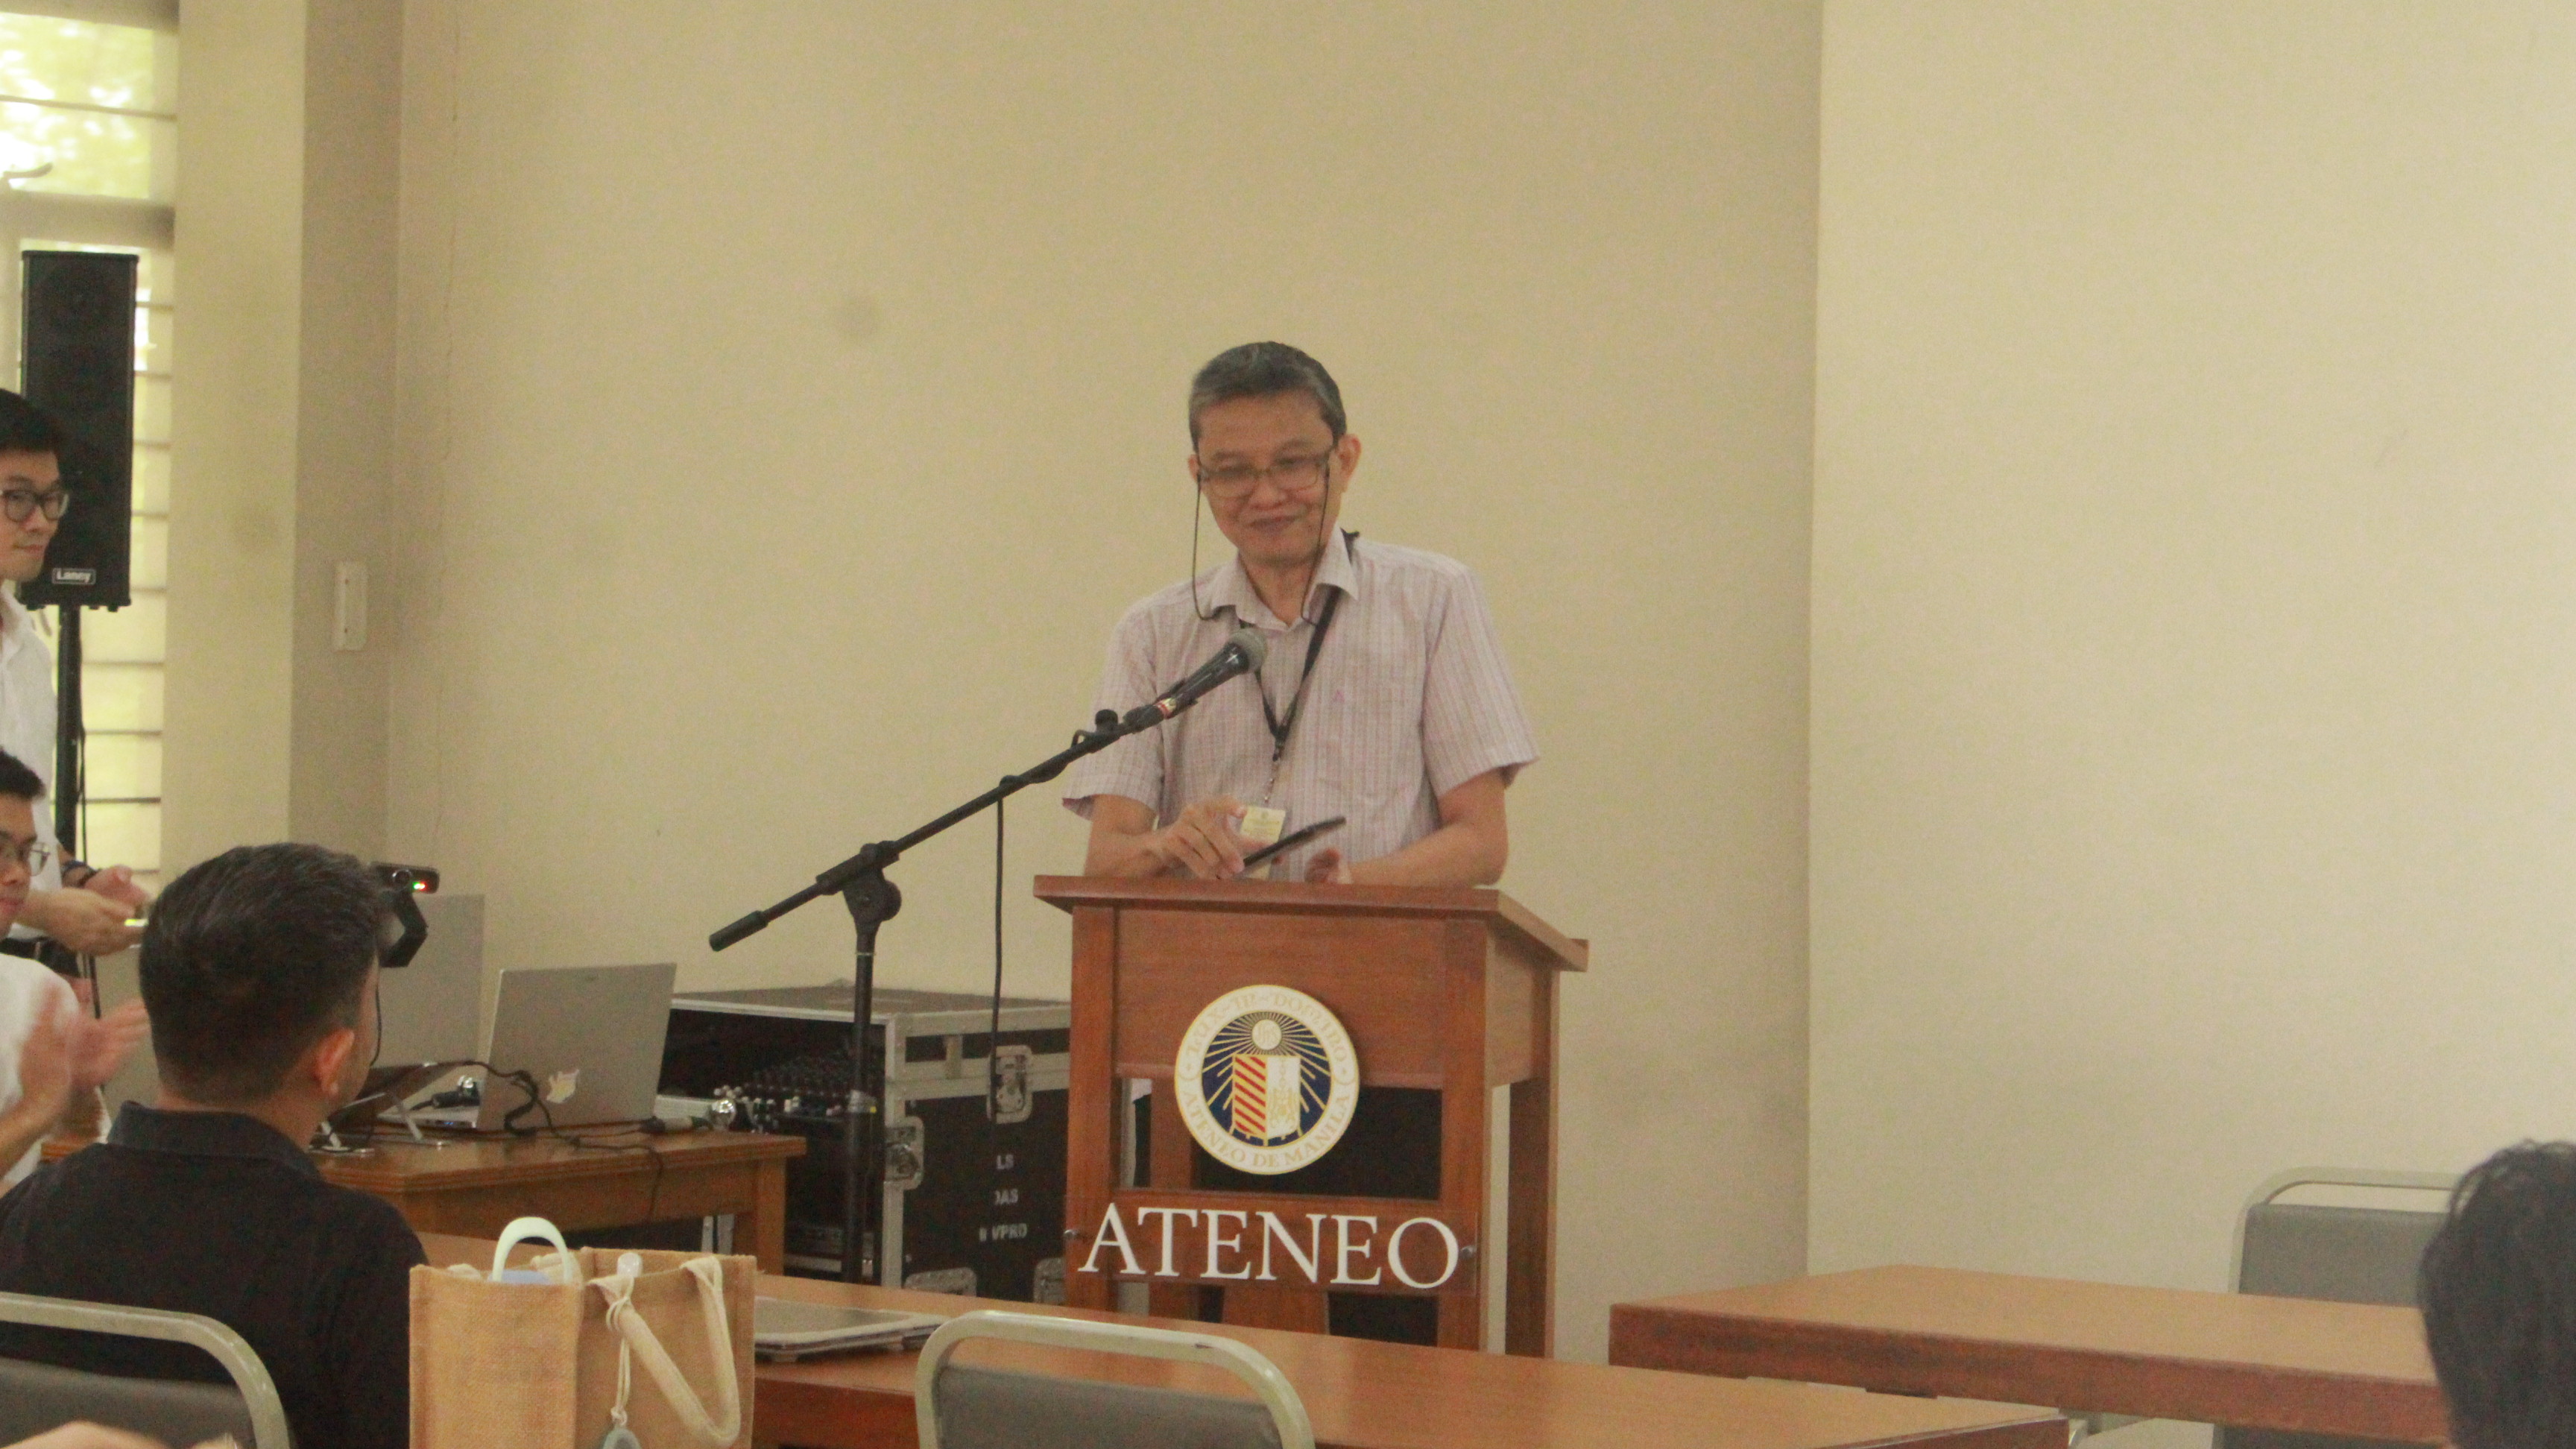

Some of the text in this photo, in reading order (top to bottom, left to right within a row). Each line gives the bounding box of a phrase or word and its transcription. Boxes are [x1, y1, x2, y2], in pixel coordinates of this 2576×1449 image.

[1181, 1091, 1350, 1167] ATENEO DE MANILA
[1078, 1202, 1459, 1289] ATENEO
